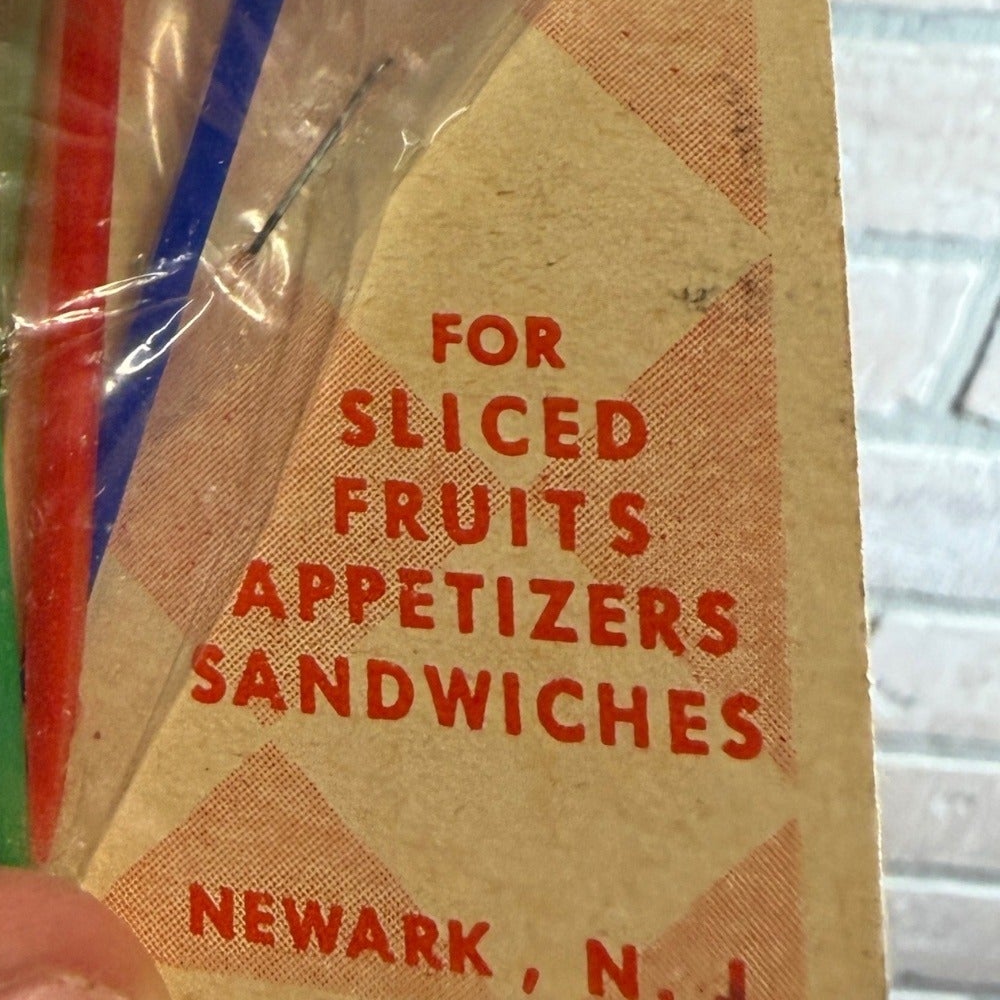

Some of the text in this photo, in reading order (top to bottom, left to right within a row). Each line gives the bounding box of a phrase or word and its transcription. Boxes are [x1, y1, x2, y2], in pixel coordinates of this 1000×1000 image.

[431, 312, 566, 369] FOR
[339, 388, 649, 461] SLICED
[333, 476, 652, 556] FRUITS
[232, 560, 739, 657] APPETIZERS
[190, 643, 764, 760] SANDWICHES
